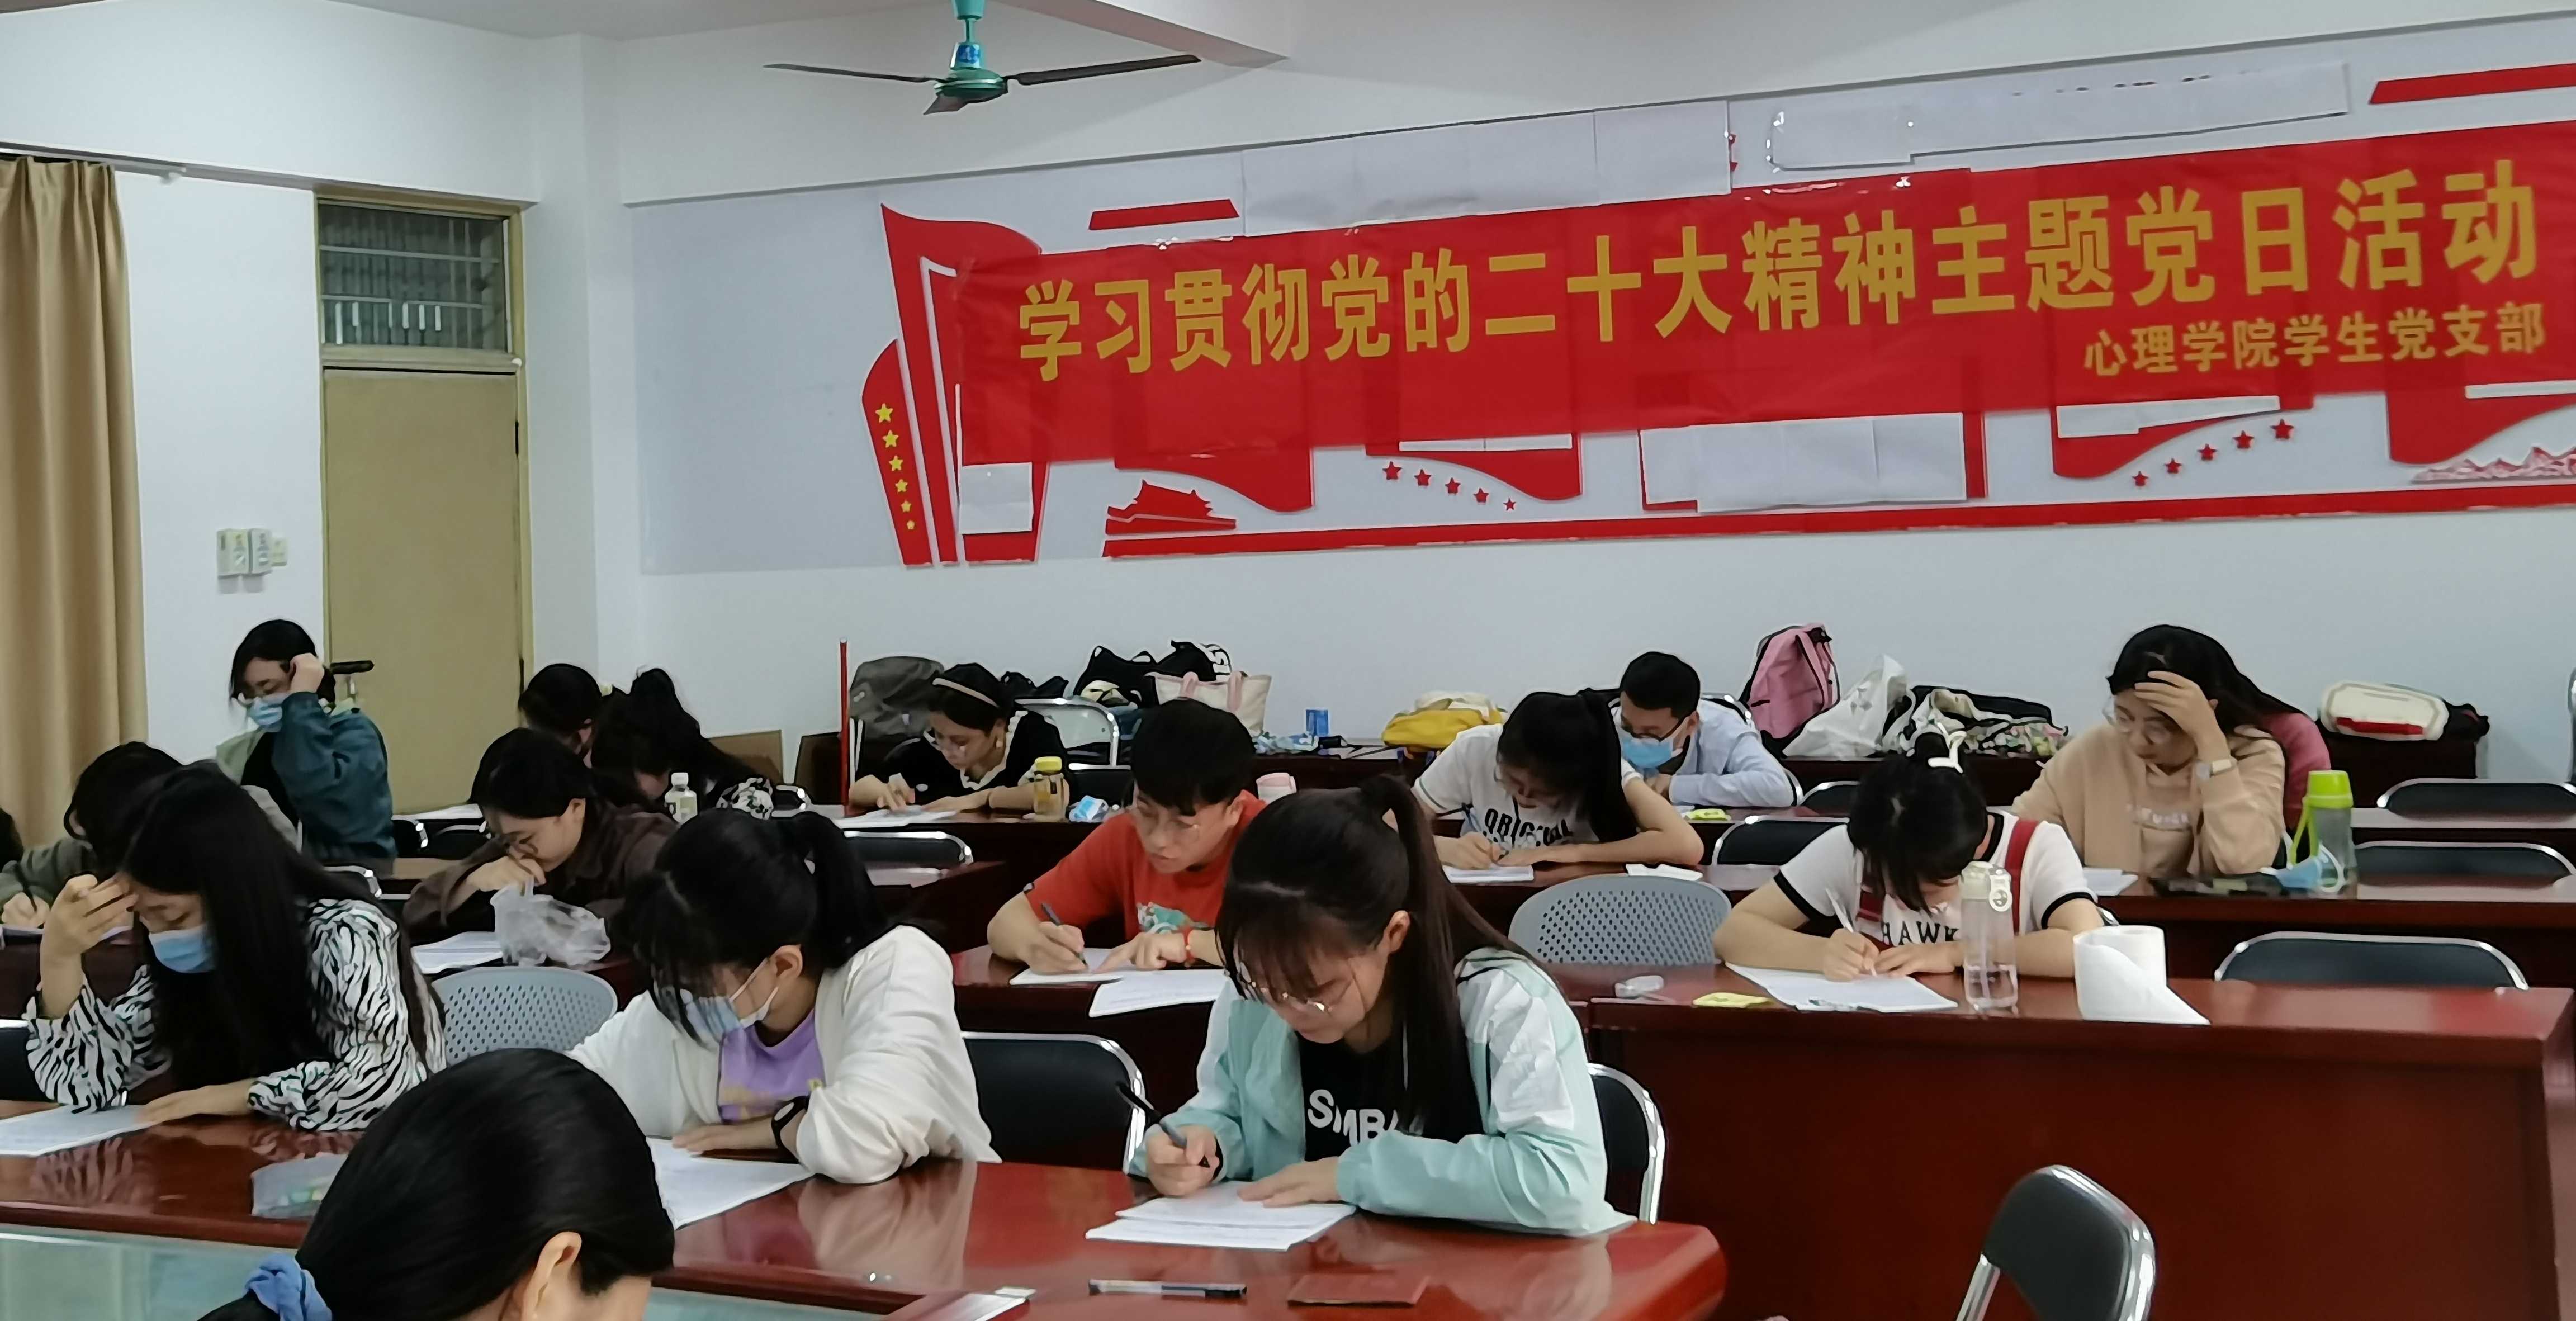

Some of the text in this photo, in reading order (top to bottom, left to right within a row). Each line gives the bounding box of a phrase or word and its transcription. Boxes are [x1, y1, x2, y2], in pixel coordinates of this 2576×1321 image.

[1019, 159, 2537, 381] 学习贯彻党的二十大精神主题党日活动
[2085, 302, 2545, 375] 心理学院学生党支部
